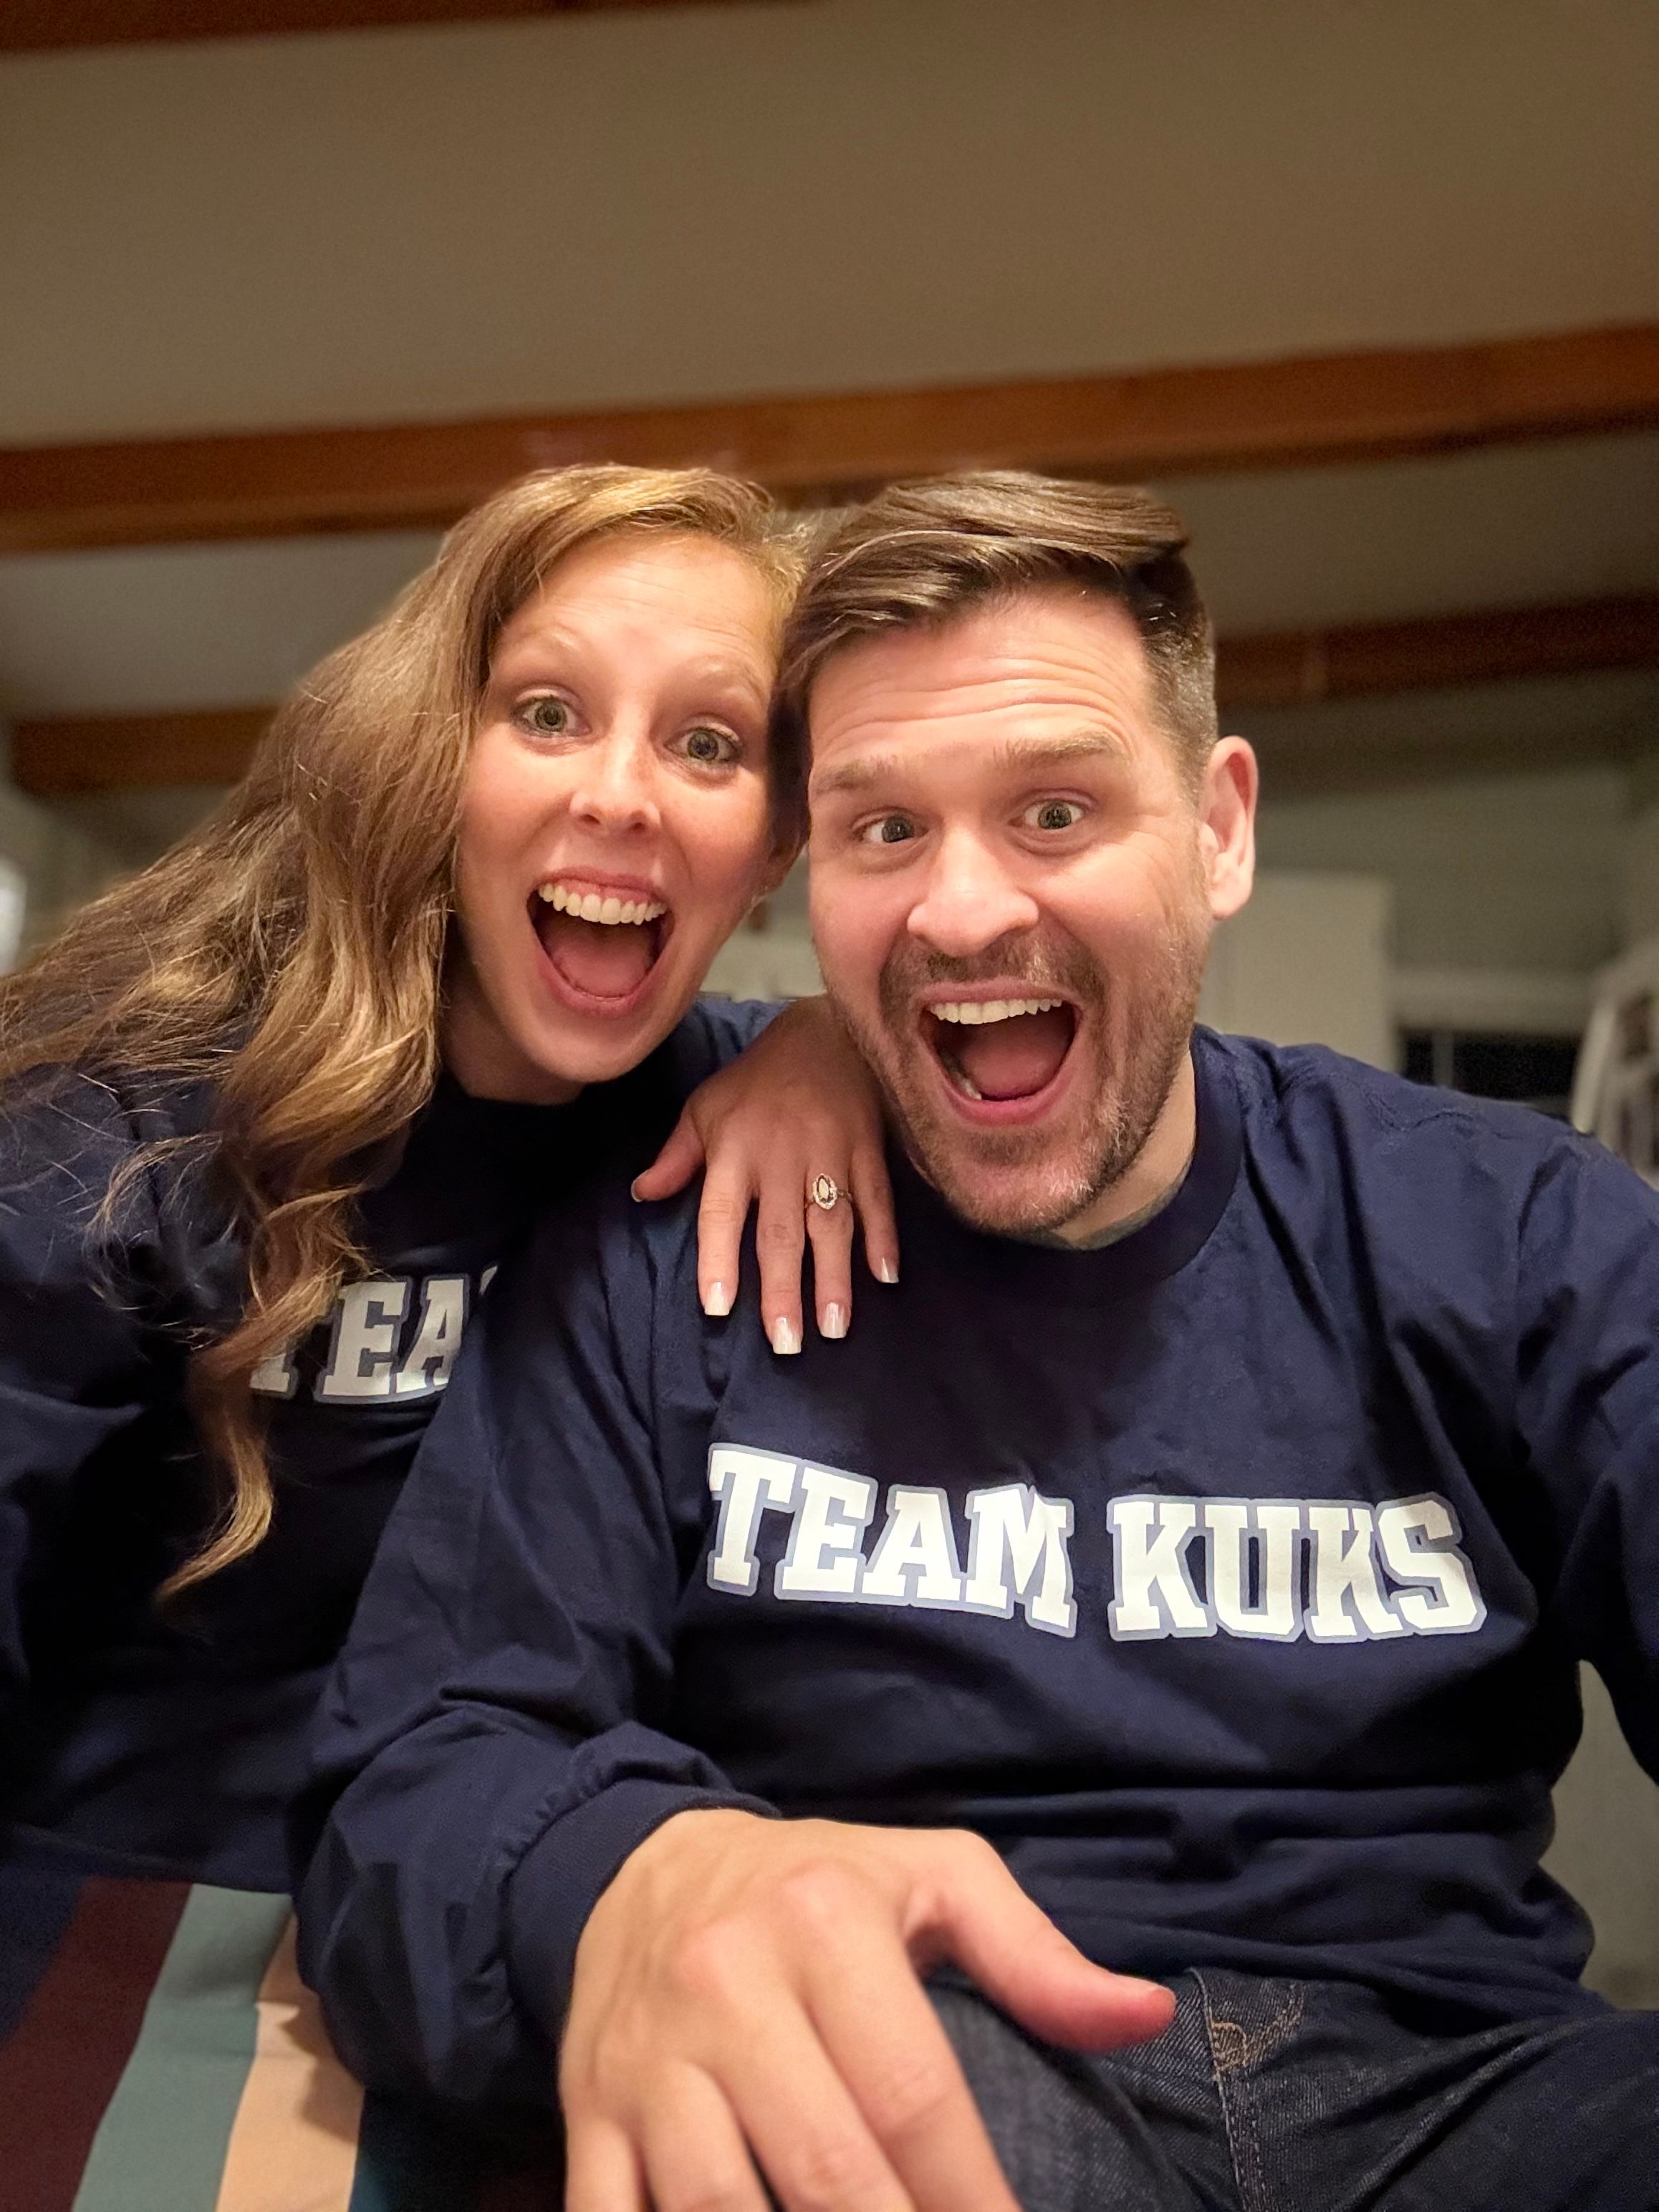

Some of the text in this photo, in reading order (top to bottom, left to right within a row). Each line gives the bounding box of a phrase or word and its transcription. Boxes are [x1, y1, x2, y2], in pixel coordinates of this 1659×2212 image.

[249, 1266, 498, 1400] EA
[708, 1443, 1486, 1643] TEAM KUKS
